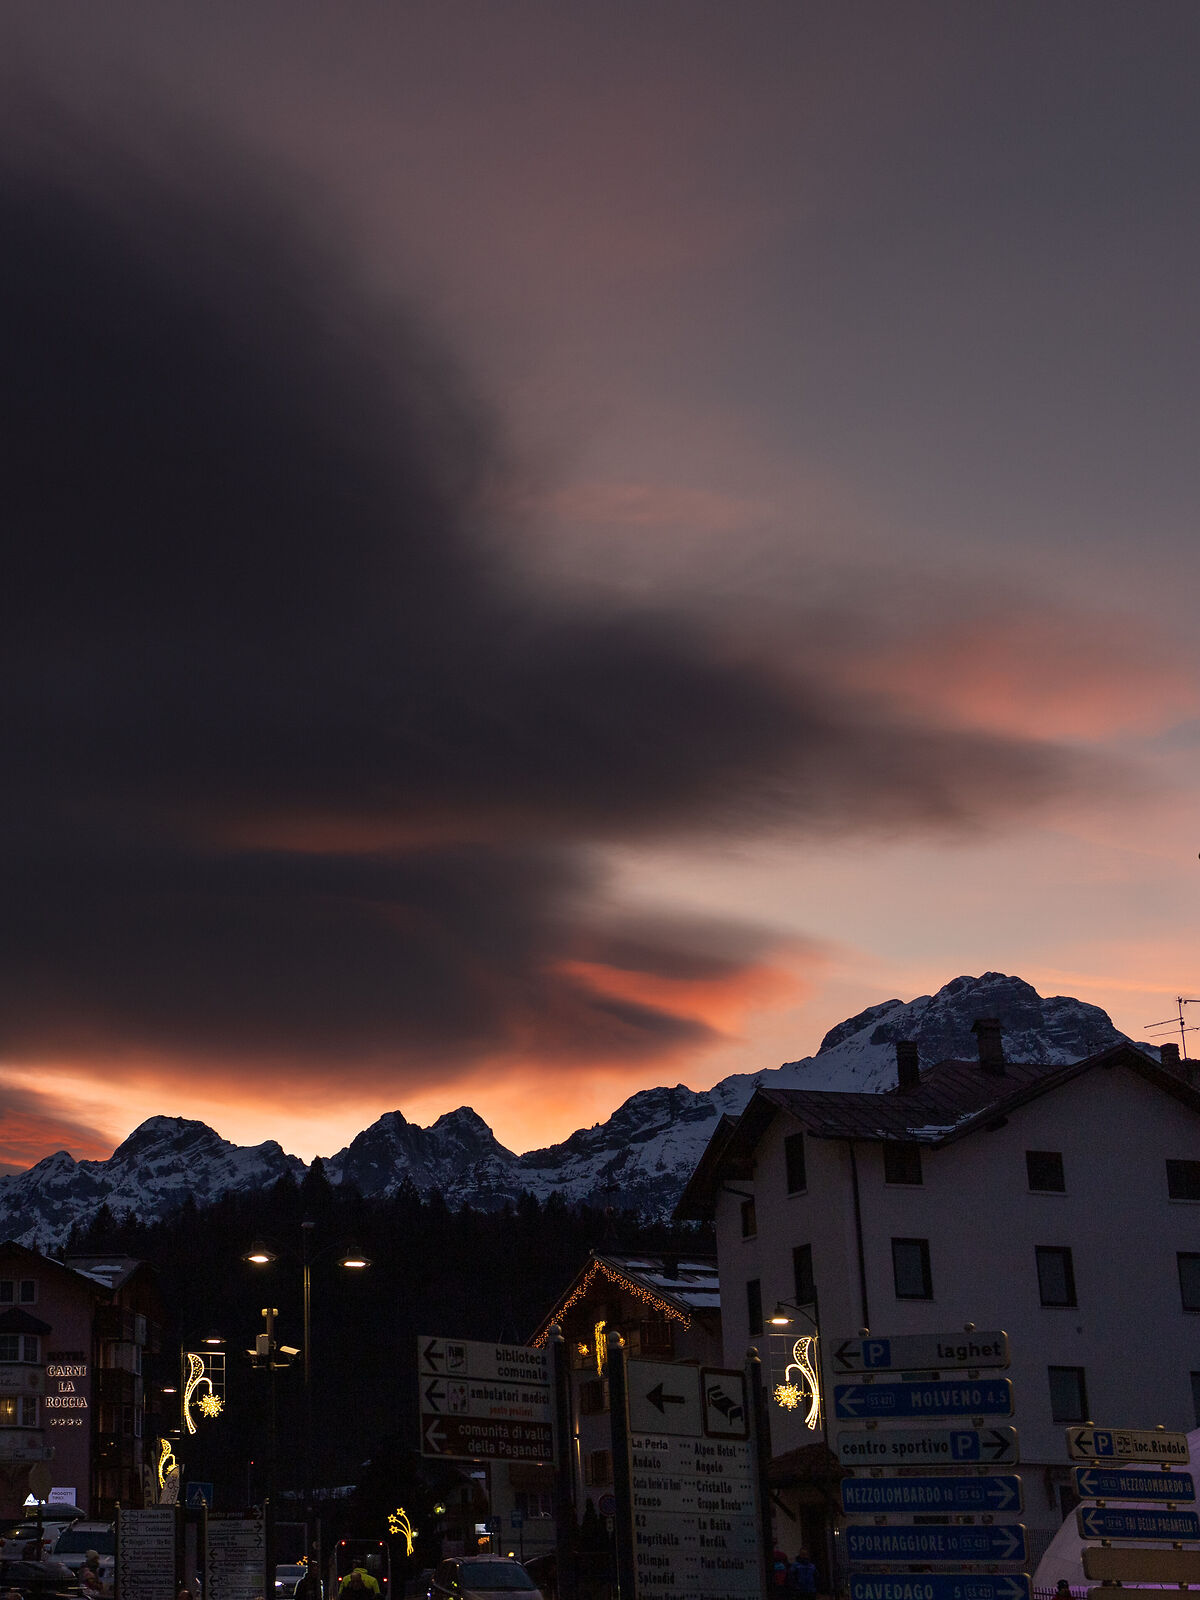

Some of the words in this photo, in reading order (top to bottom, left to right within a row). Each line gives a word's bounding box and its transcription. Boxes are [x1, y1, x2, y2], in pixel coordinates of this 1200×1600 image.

[496, 1349, 547, 1365] biblioteca
[47, 1365, 87, 1377] GARNI
[498, 1367, 548, 1380] comunale
[58, 1381, 75, 1392] LA
[45, 1396, 88, 1408] ROCCIA
[471, 1387, 519, 1402] ambulatori
[521, 1391, 550, 1404] medici
[910, 1390, 981, 1408] MOLVENO
[459, 1424, 509, 1438] comunità
[512, 1425, 522, 1438] di
[524, 1427, 552, 1440] valle
[467, 1440, 496, 1453] della
[498, 1441, 553, 1458] Paganella
[632, 1438, 643, 1449] La
[645, 1439, 668, 1450] Perla
[695, 1443, 715, 1457] Alpen
[717, 1444, 737, 1457] Hotel
[842, 1439, 886, 1455] centro
[891, 1438, 949, 1457] sportivo
[632, 1455, 661, 1469] Andalo
[696, 1480, 732, 1493] Cristallo
[1120, 1477, 1184, 1493] MEZZOLOMBARDO
[633, 1494, 662, 1506] Franco
[846, 1486, 940, 1504] MEZZOLOMBARDO
[698, 1497, 719, 1512] Gruppo
[635, 1514, 646, 1527] K2
[698, 1517, 707, 1530] La
[710, 1518, 731, 1531] Baita
[1137, 1517, 1157, 1531] DELLA
[1157, 1517, 1193, 1533] PAGANELLA
[636, 1531, 679, 1547] Negritella
[700, 1534, 727, 1548] Nordik
[850, 1535, 945, 1551] SPORMAGGIORE
[637, 1553, 670, 1568] Olimpia
[638, 1571, 675, 1588] Splendid
[854, 1583, 934, 1600] CAVEDAGO
